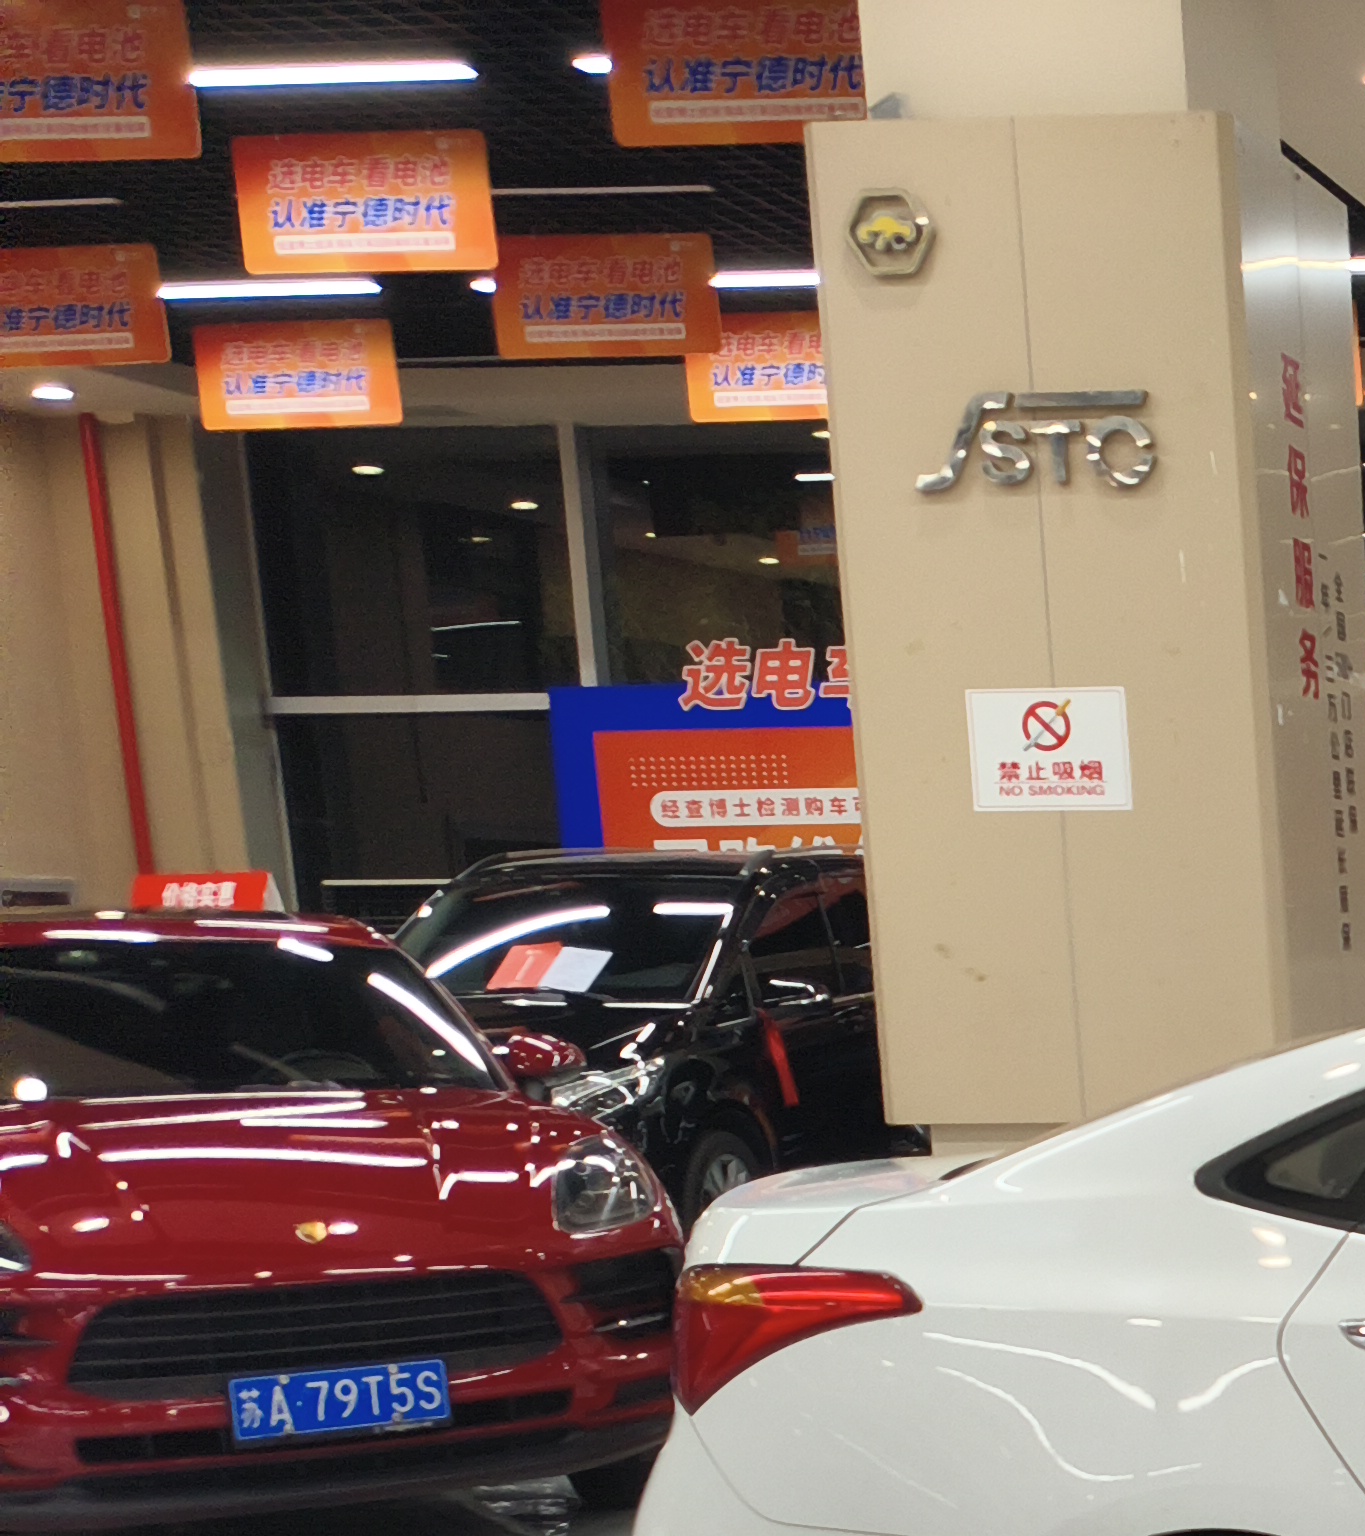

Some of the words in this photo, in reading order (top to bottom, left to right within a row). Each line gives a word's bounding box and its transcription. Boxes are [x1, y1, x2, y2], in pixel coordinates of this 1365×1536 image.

[646, 54, 863, 93] 认准宁德时代
[0, 73, 149, 112] 宁德时代
[270, 195, 453, 229] 认准宁德时代
[521, 293, 684, 320] 认准宁德时代
[998, 760, 1104, 782] 禁止吸烟
[999, 785, 1023, 796] NO
[1028, 784, 1105, 796] SMOKING
[661, 797, 861, 820] 经查博士检测购车
